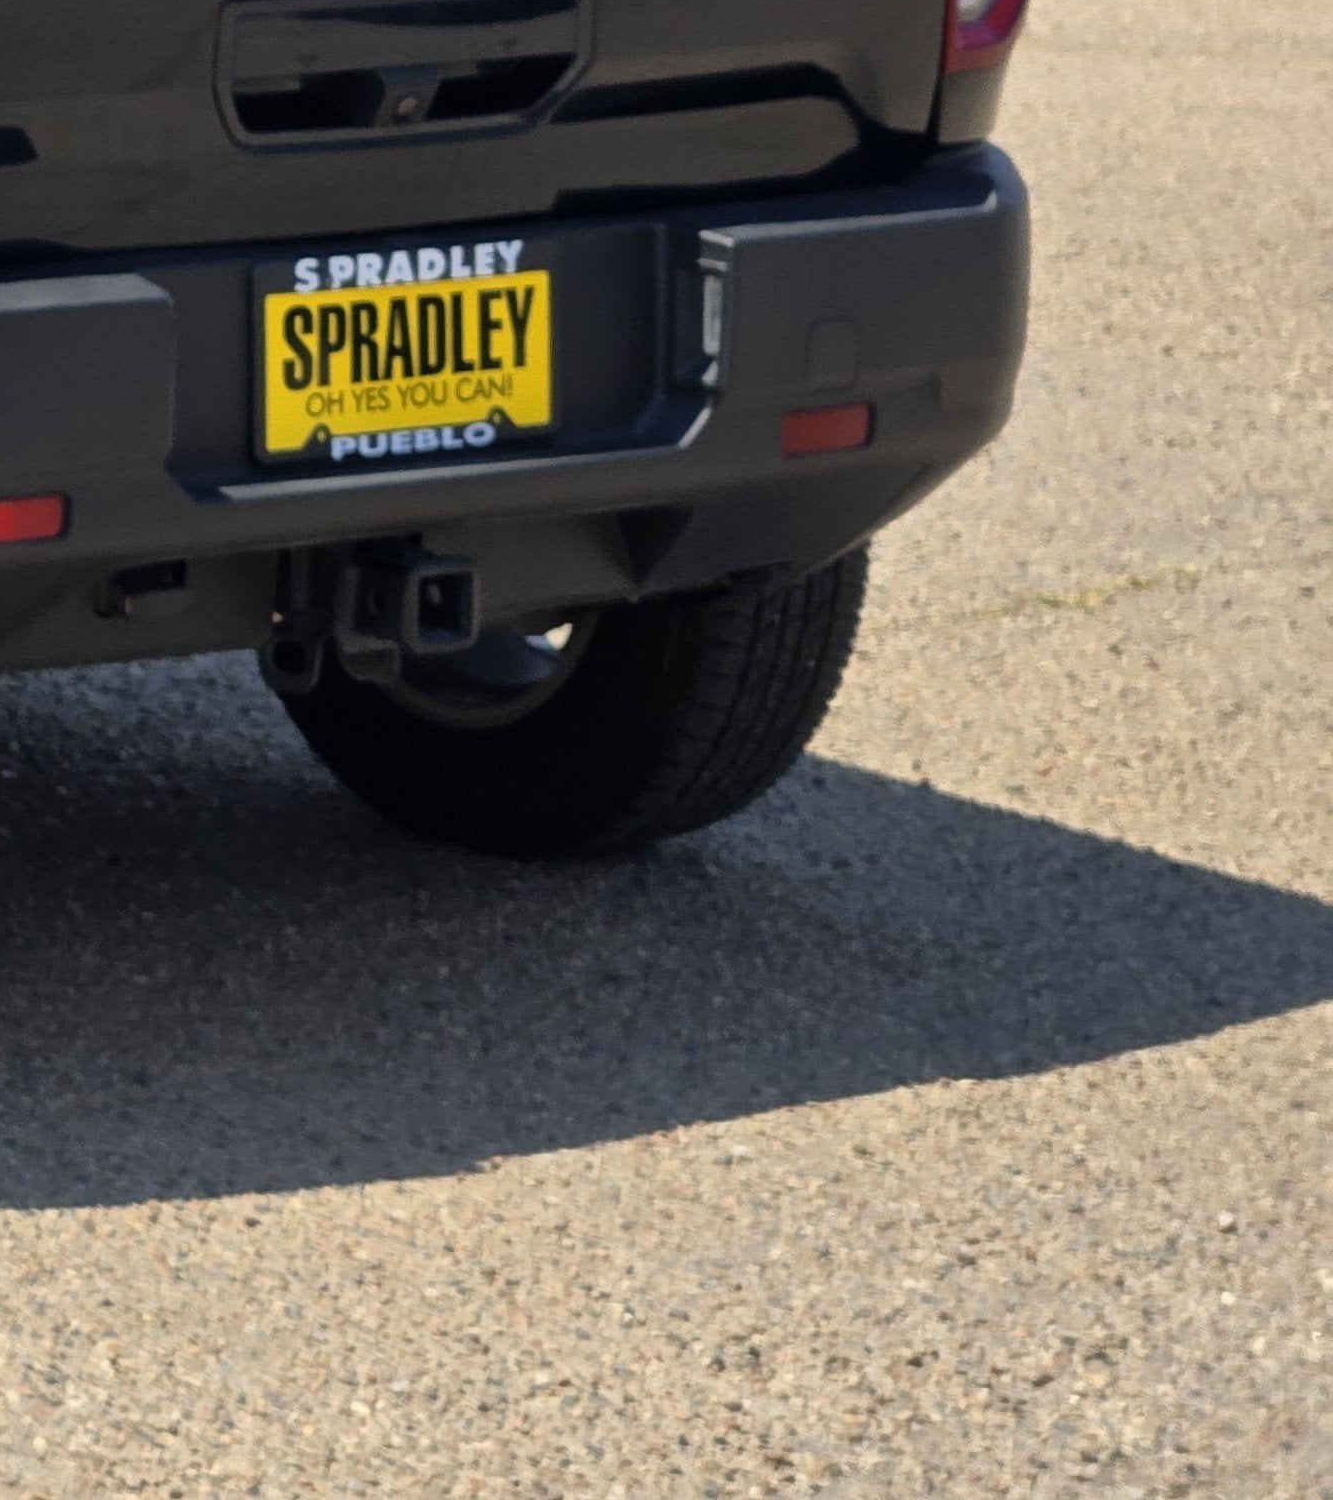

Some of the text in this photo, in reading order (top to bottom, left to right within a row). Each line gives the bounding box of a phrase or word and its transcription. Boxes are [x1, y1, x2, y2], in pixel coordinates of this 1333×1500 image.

[282, 284, 536, 391] SPRADLEY
[304, 372, 514, 418] OH YES YOU CAN!
[329, 420, 497, 462] PUEBLO
